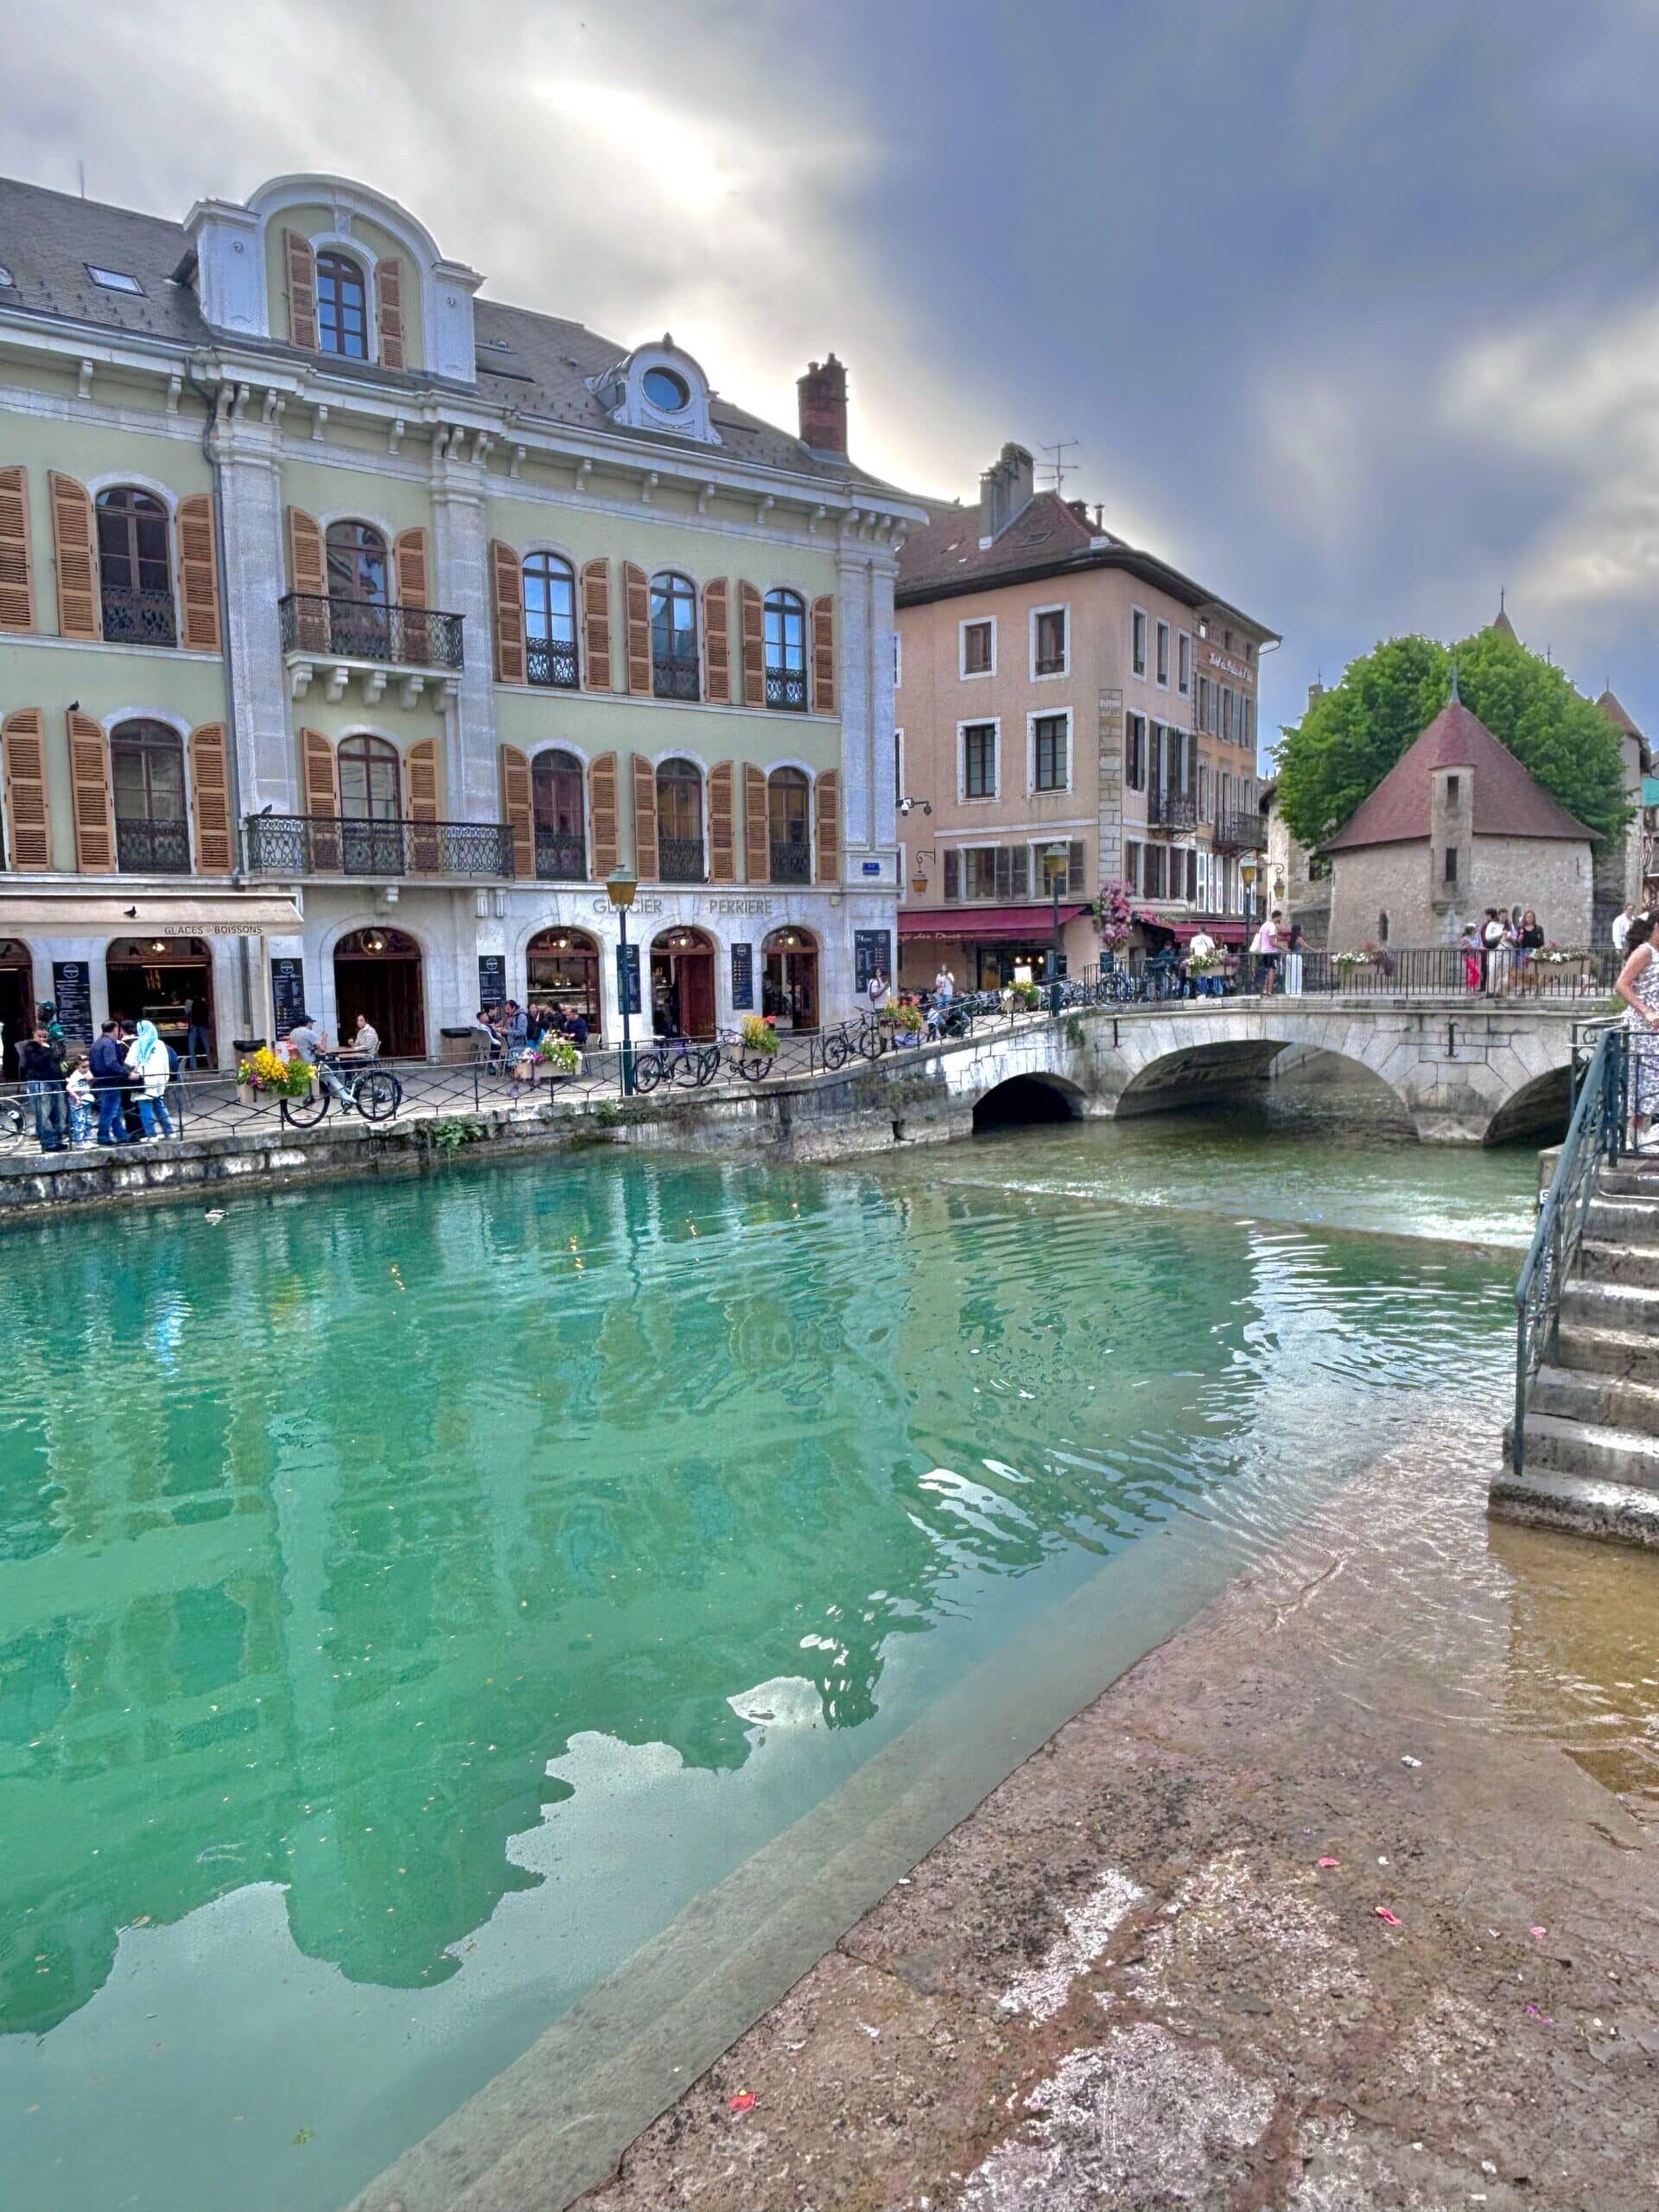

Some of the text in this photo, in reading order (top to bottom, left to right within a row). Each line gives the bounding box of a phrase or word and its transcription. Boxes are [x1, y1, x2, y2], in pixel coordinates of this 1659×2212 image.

[593, 898, 662, 913] GLCIER
[164, 925, 264, 935] GLACES BOISSONS
